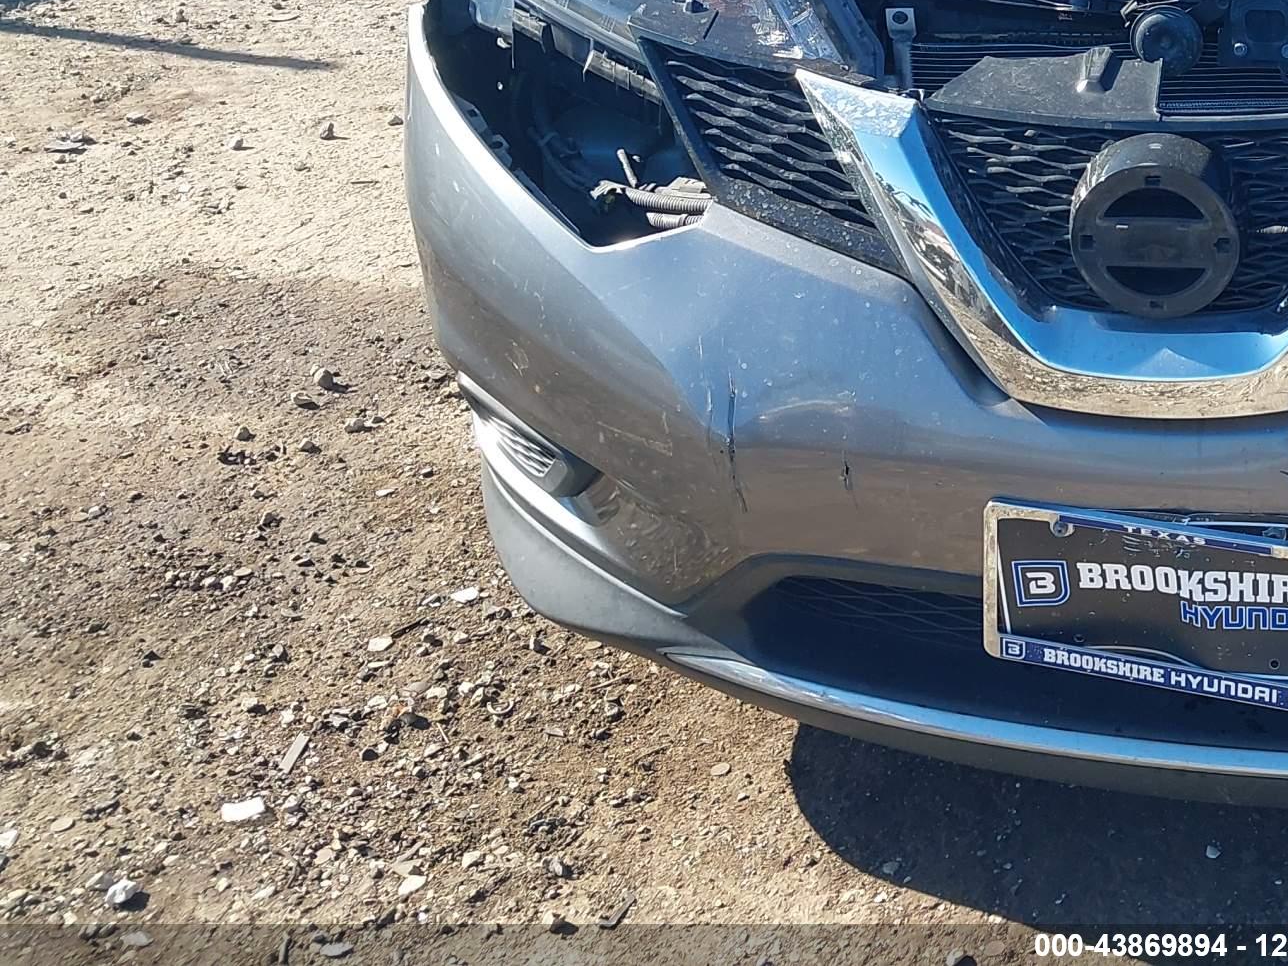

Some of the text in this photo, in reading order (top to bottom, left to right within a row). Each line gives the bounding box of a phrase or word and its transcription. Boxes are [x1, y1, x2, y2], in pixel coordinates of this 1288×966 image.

[1123, 525, 1206, 545] TEXAS
[1043, 647, 1164, 684] BROOKSHIRE
[1169, 672, 1278, 705] HYUNDAI
